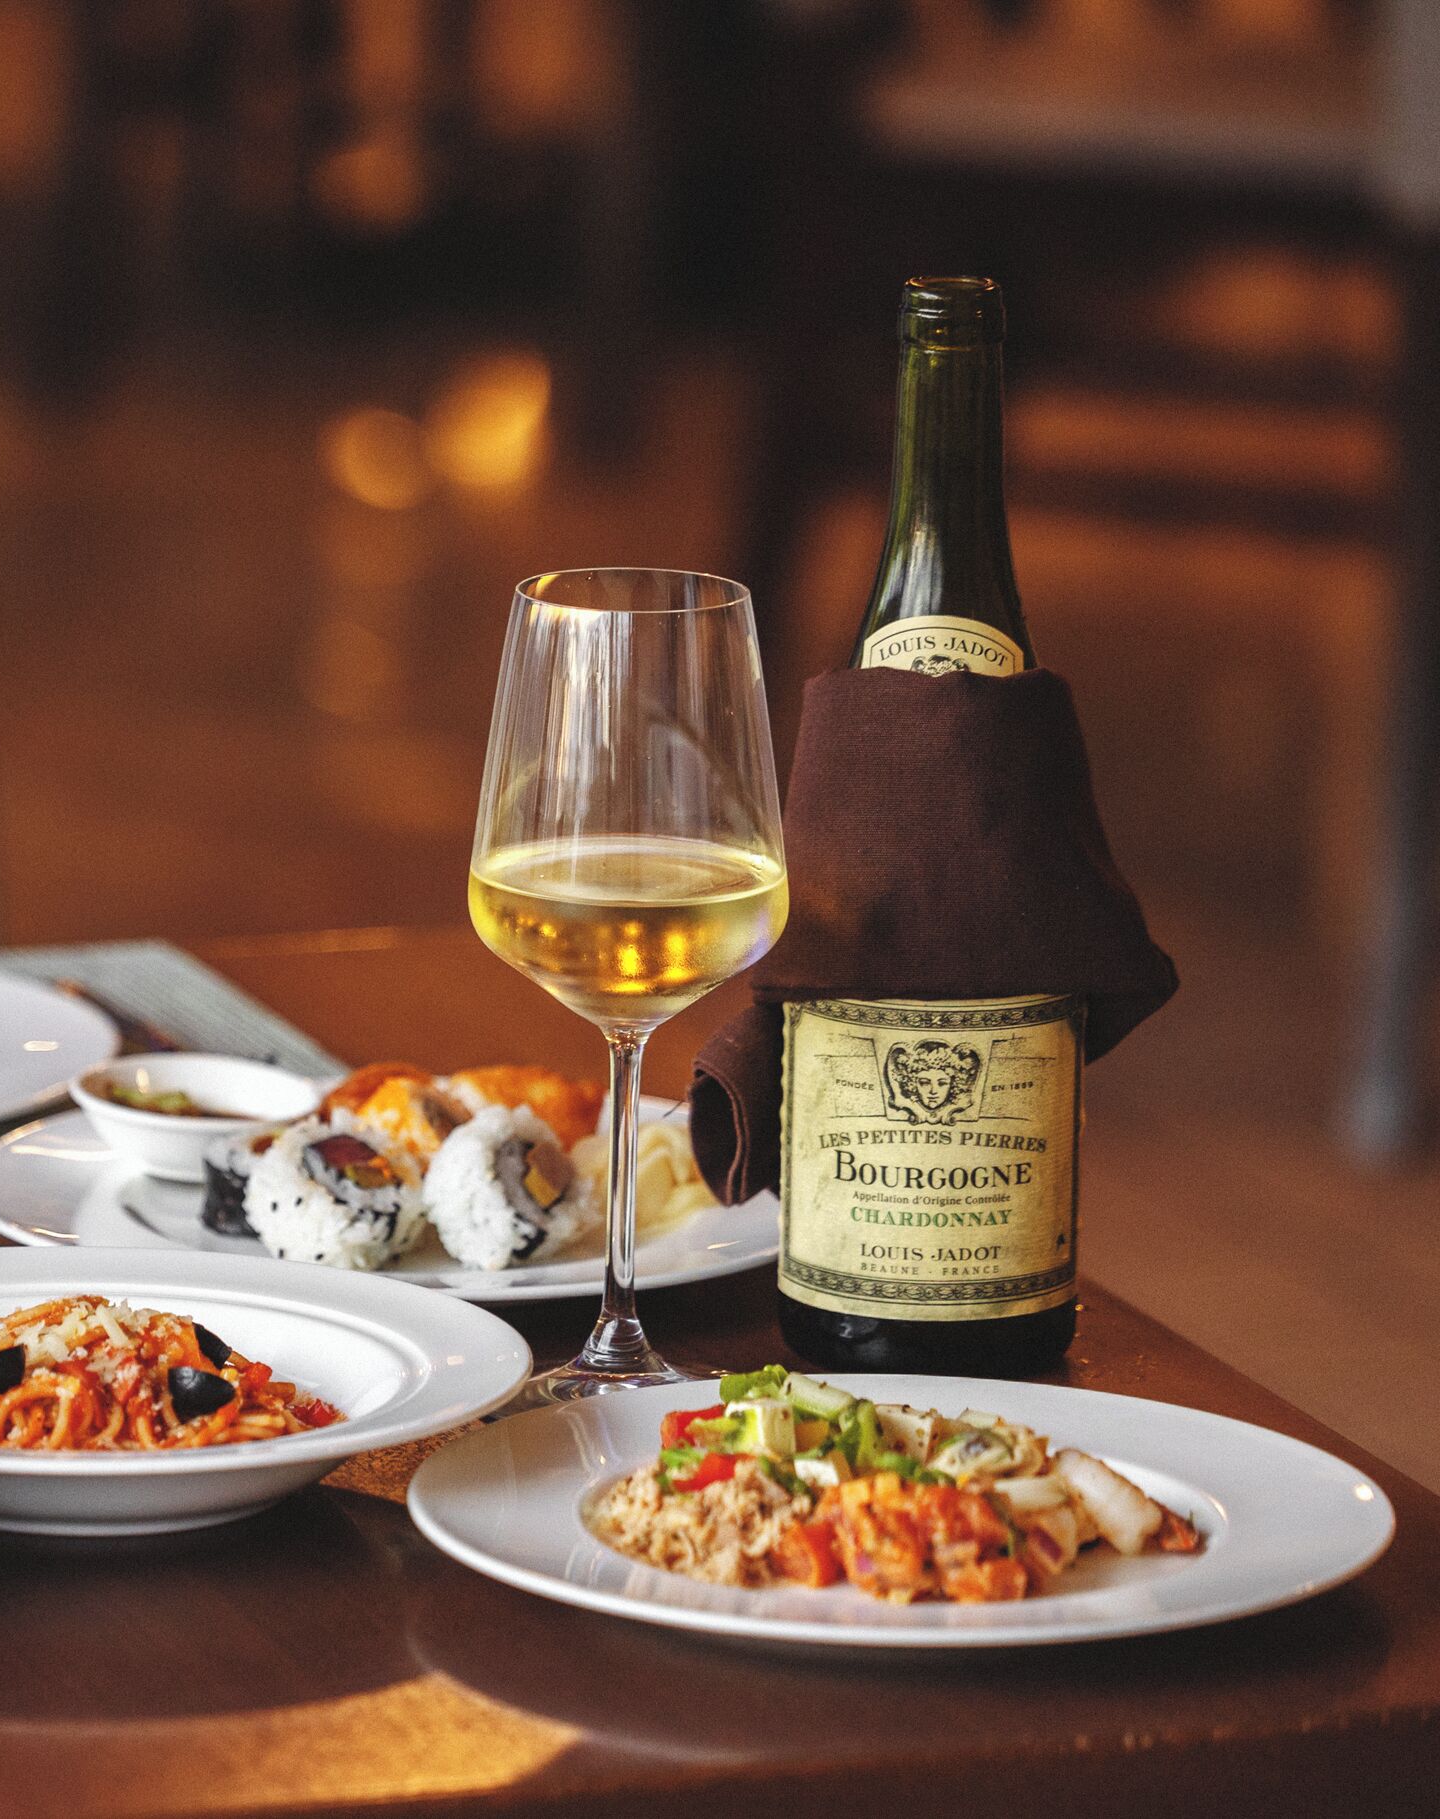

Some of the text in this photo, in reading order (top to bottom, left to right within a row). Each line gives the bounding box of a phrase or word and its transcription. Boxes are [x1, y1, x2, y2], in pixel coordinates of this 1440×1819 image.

[879, 636, 1009, 667] LOUIS JADOT
[835, 1078, 875, 1091] FONDÉE
[991, 1084, 1006, 1092] EN
[818, 1130, 1047, 1153] LES PETITES PIERRES
[833, 1149, 1032, 1190] BOURGOGNE
[852, 1190, 910, 1205] Appellation
[965, 1192, 1011, 1205] Contrôlée
[850, 1206, 1013, 1228] CHARDONNAY
[860, 1243, 1001, 1262] LOUIS JADOT
[860, 1262, 919, 1276] BEAUNE
[942, 1265, 1000, 1276] FRANCE
